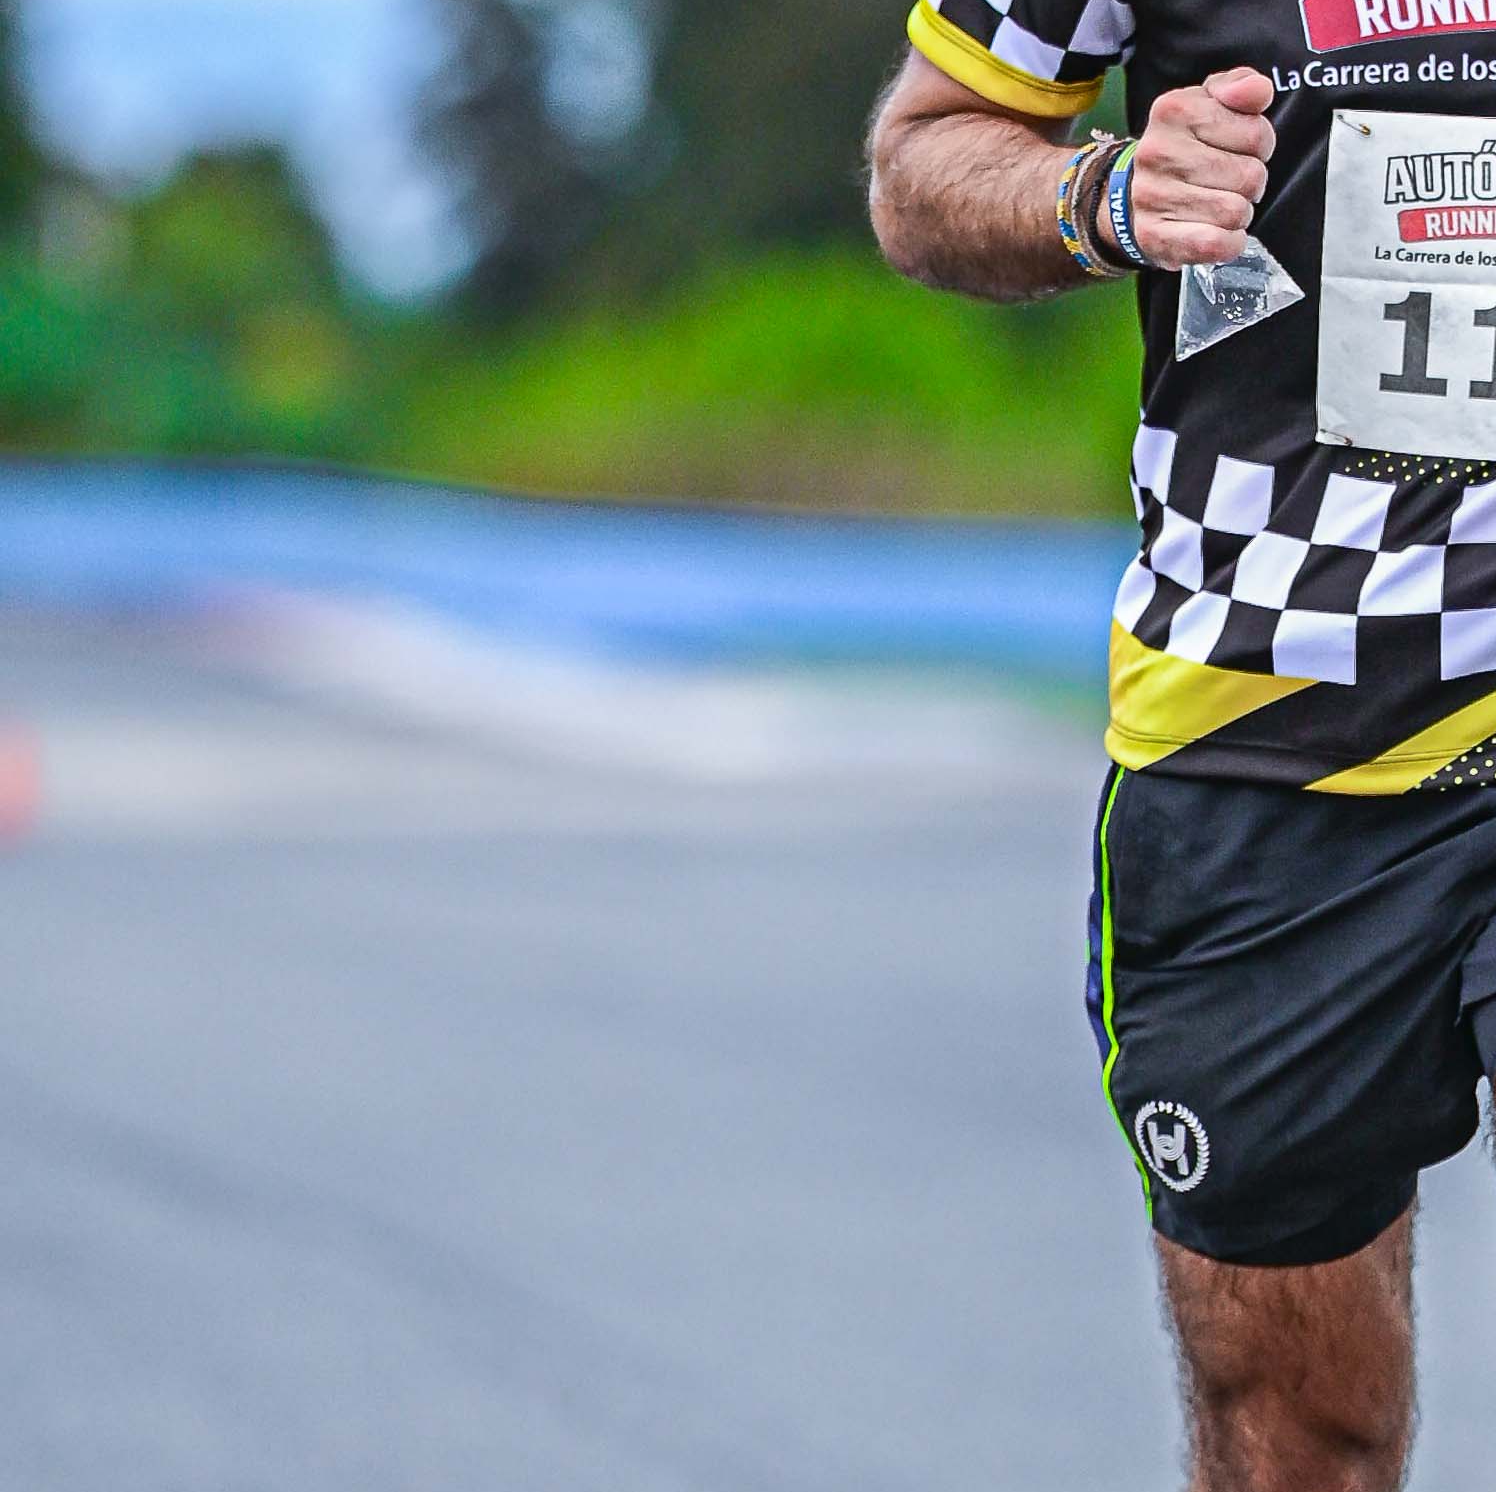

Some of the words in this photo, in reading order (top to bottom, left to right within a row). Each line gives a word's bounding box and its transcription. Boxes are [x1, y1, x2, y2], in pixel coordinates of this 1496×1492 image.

[1272, 66, 1300, 92] La
[1303, 60, 1410, 87] Carrera
[1417, 53, 1454, 81] de
[1111, 187, 1142, 259] CENTRAL
[1374, 245, 1391, 261] La
[1395, 247, 1451, 264] Carrera
[1454, 250, 1475, 266] de
